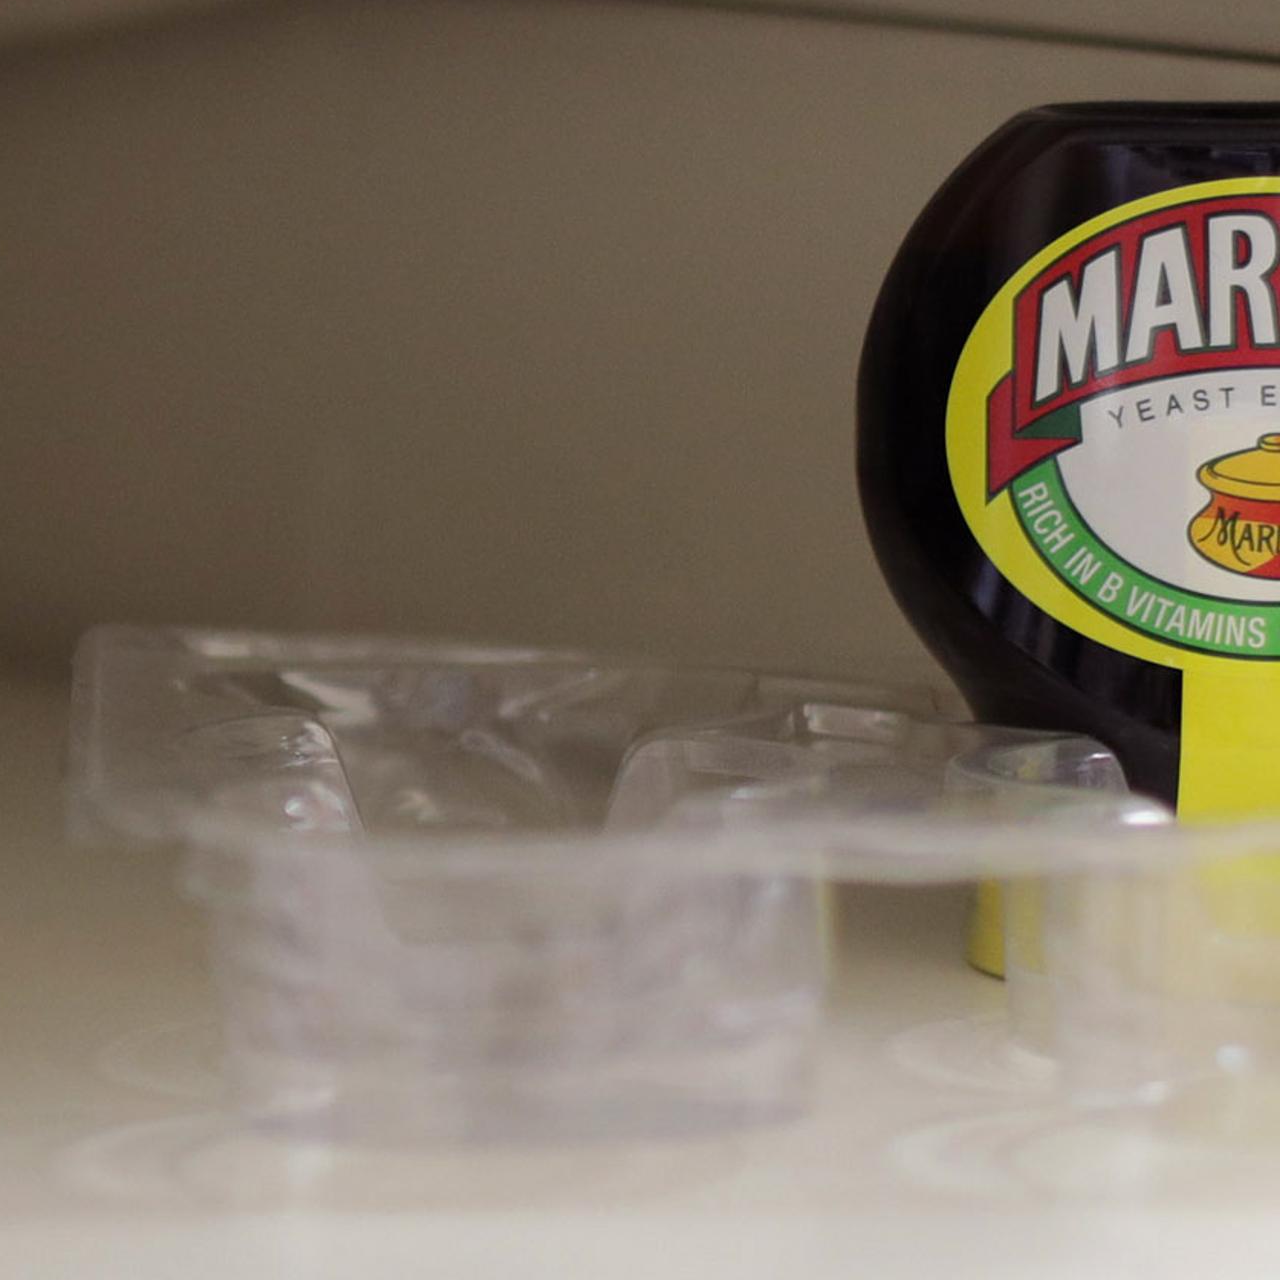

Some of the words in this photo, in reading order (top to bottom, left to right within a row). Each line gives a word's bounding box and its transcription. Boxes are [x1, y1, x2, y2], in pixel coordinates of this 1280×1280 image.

[1035, 214, 1278, 402] MAR
[1108, 387, 1234, 428] YEAST
[1018, 481, 1075, 554] RICH
[1064, 547, 1102, 585] IN
[1097, 571, 1124, 603] B
[1126, 585, 1266, 648] VITAMINS
[1197, 506, 1280, 566] MAR
